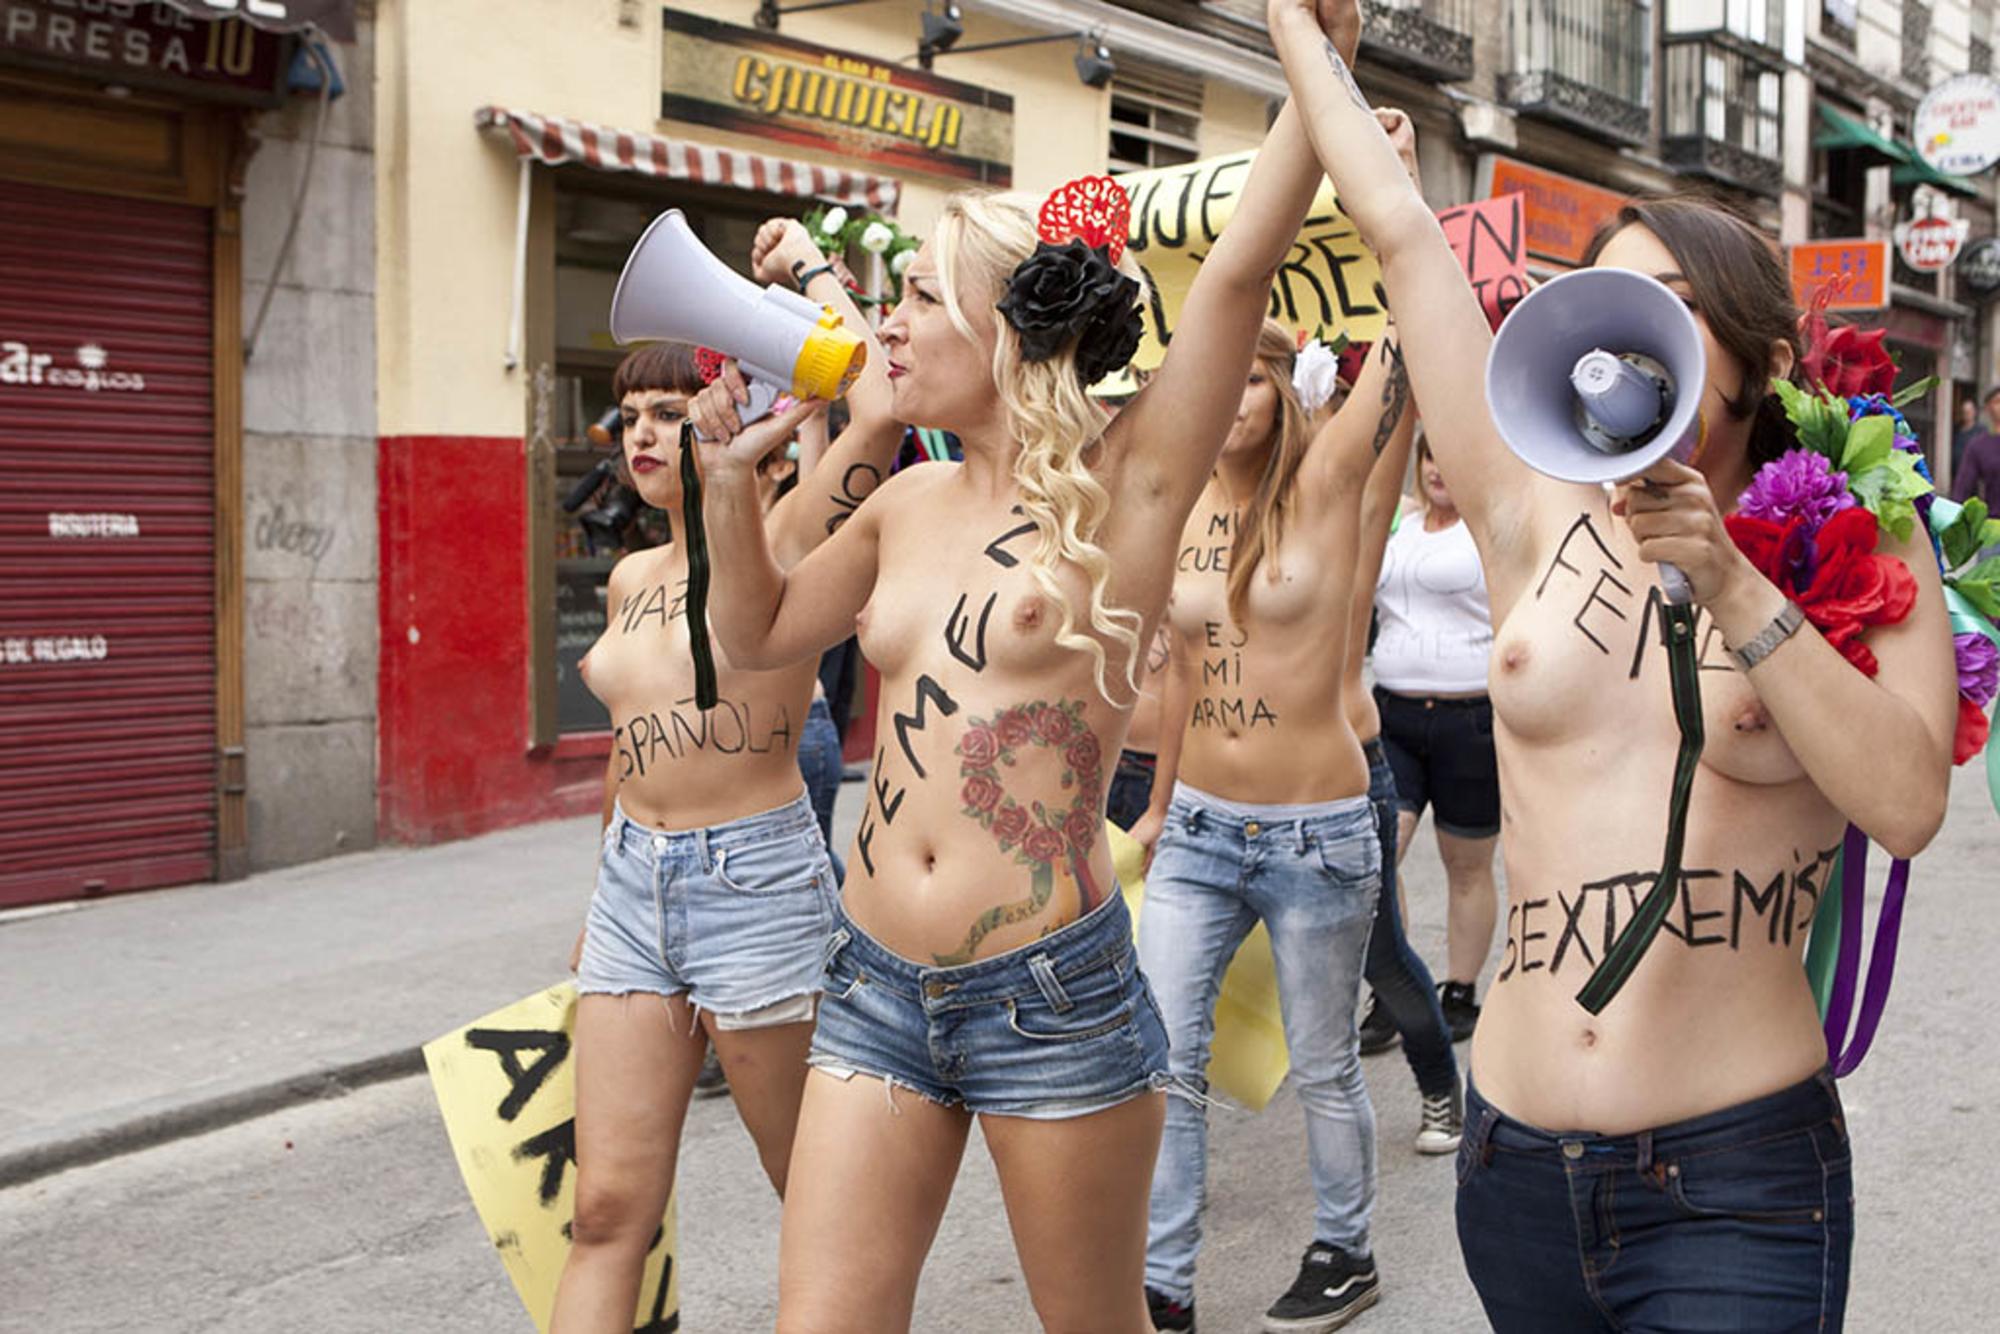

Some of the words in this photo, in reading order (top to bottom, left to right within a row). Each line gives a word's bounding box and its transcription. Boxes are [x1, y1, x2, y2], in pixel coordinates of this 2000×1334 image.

[733, 54, 962, 149] CANDELA
[1178, 545, 1231, 573] CUE
[1191, 697, 1278, 730] ARMA
